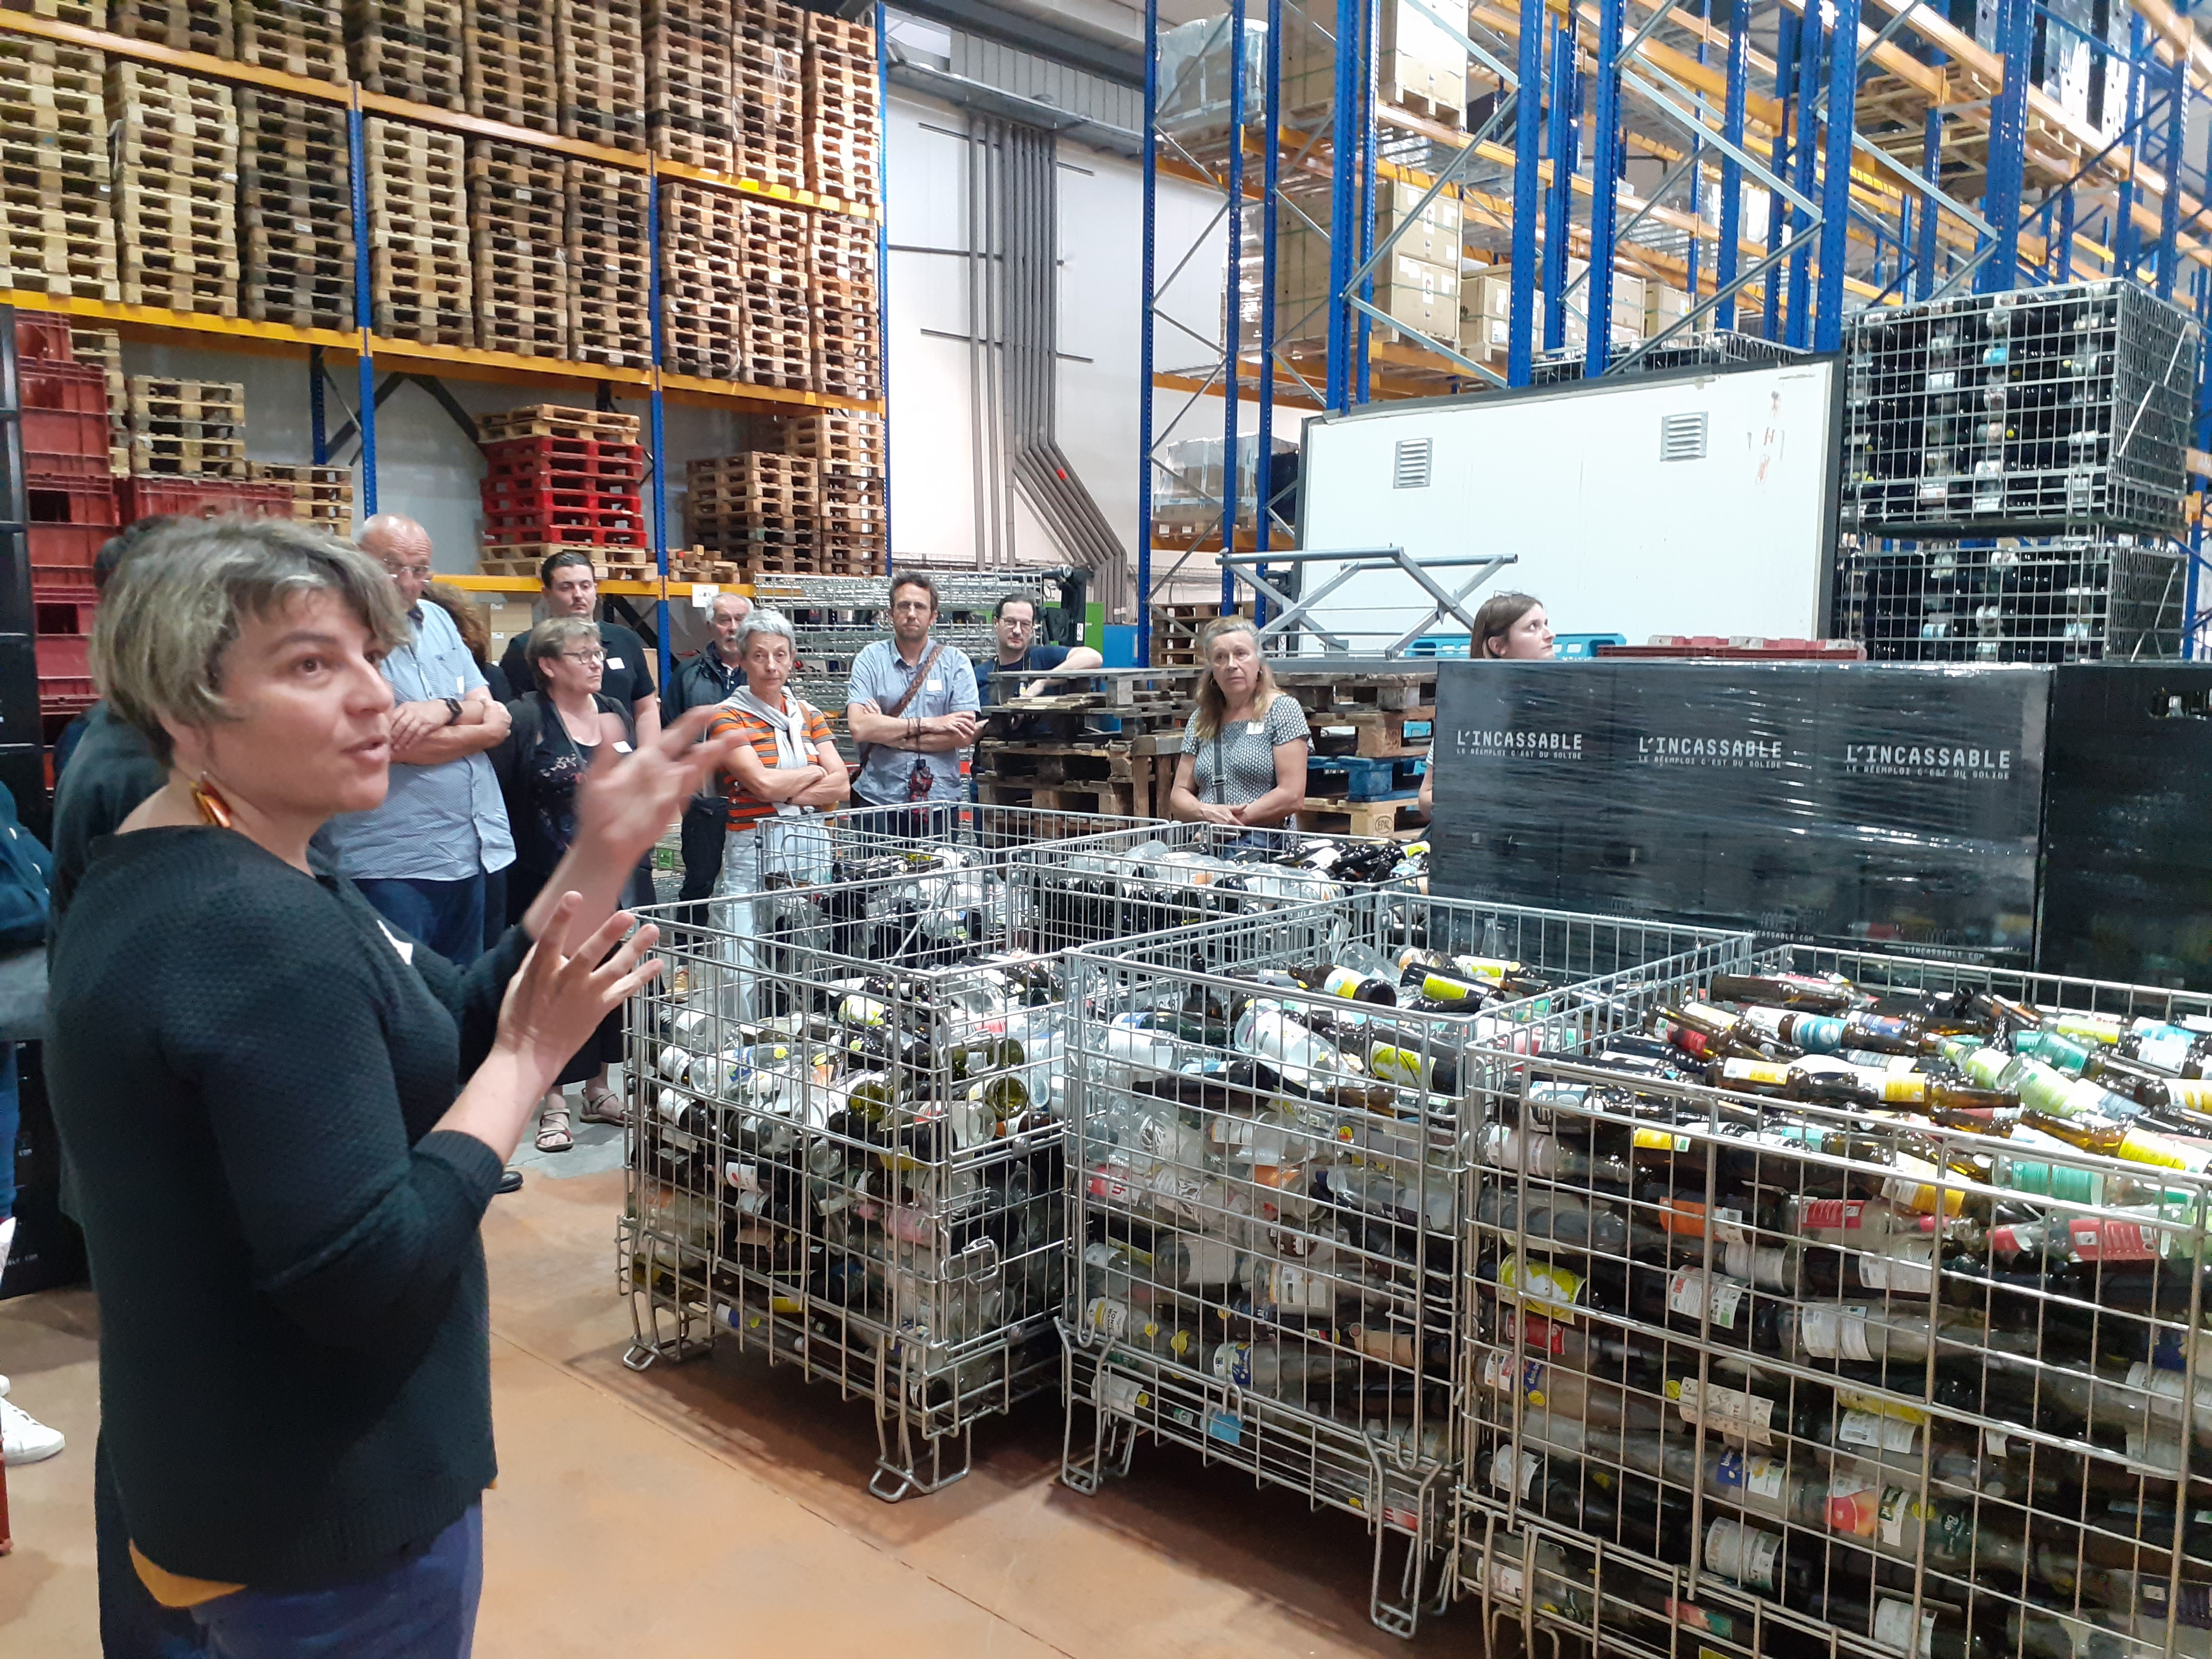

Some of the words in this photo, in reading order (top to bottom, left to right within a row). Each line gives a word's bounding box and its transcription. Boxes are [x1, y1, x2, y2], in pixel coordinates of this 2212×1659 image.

[1457, 730, 1582, 750] L'INCASSABLE
[1639, 736, 1782, 759] L'INCASSABLE
[1470, 747, 1506, 756] RÉEMPLOI
[1511, 750, 1534, 758] C'EST
[1554, 751, 1581, 760] SOLIDE
[1654, 755, 1695, 765] RÉEMPLOI
[1749, 760, 1781, 768] SOLIDE
[1847, 744, 2010, 769] L'INCASSABLE
[1847, 765, 1857, 773] LE
[1864, 765, 1910, 775] RÉEMPLOI
[1917, 768, 1947, 777] C'EST
[1954, 769, 1966, 779] DU
[1972, 770, 2009, 780] SOLIDE
